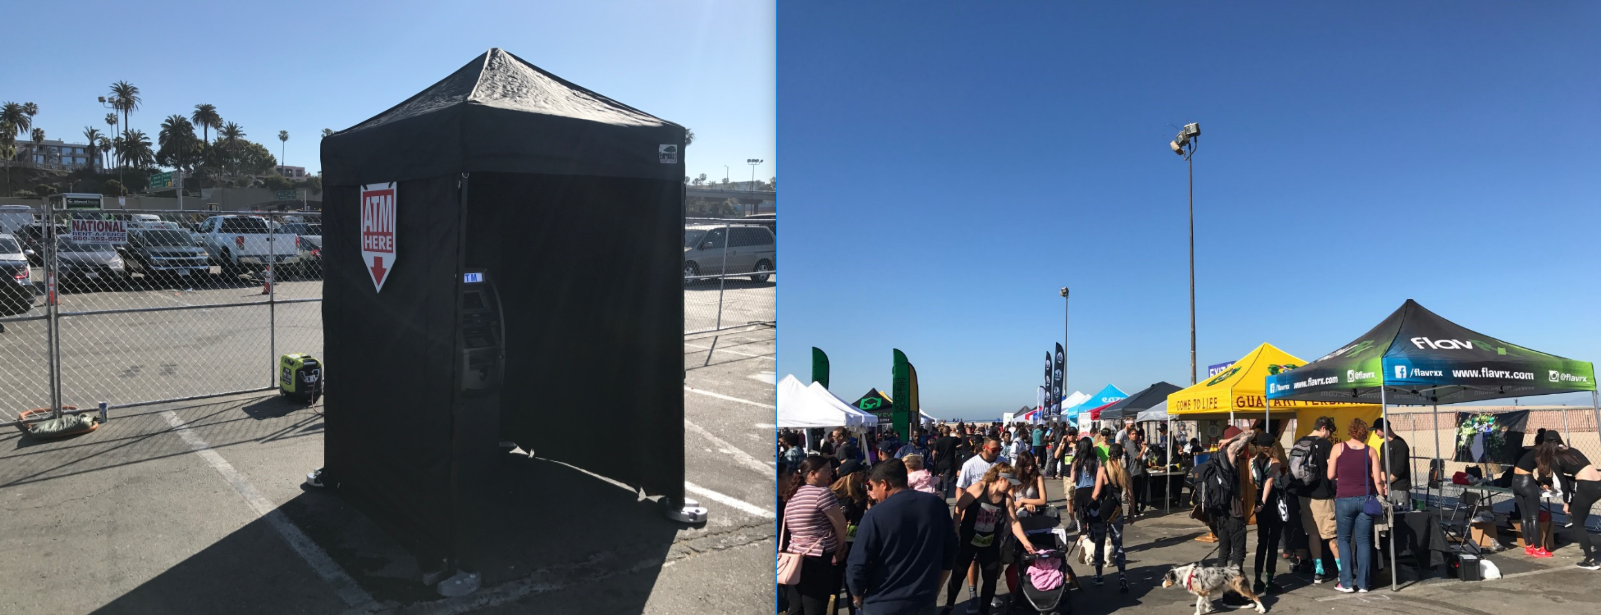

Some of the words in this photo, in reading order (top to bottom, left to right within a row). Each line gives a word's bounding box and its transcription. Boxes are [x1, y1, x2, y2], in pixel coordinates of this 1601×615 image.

[363, 195, 393, 233] ATM
[72, 220, 126, 232] NATIONAL
[364, 234, 393, 250] HERE
[464, 273, 478, 282] TM
[1452, 367, 1534, 380] www.flavrx.com
[1293, 375, 1338, 389] www.flavrx.com
[1176, 400, 1191, 411] COME
[1193, 398, 1201, 410] TO
[1202, 397, 1218, 409] LIFE
